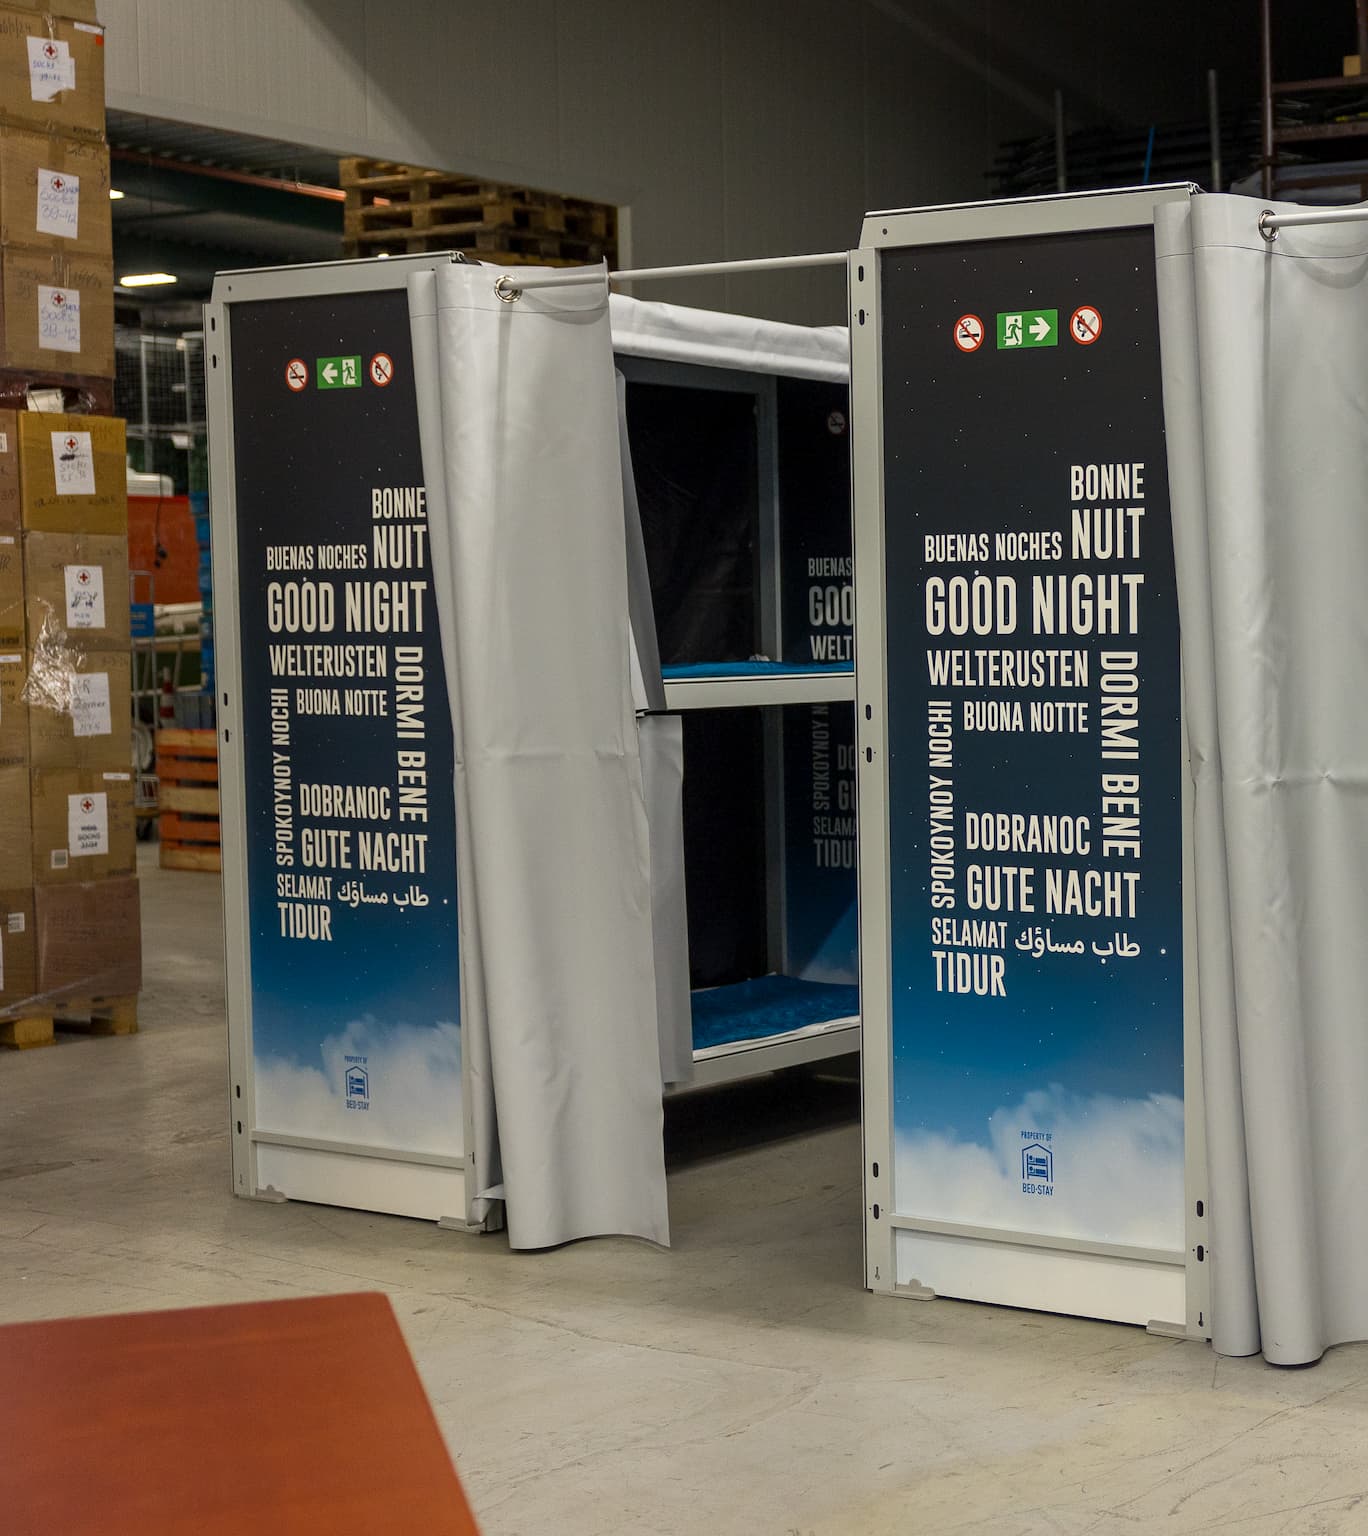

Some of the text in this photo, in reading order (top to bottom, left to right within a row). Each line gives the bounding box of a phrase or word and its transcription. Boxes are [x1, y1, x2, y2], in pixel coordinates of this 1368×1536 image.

[1070, 463, 1145, 500] BONNE
[372, 487, 426, 518] BONNE
[373, 524, 427, 569] NUIT
[924, 531, 1062, 562] BUENAS NOCHES
[1071, 507, 1145, 559] NUIT
[266, 544, 367, 570] BUENAS NOCHES
[808, 557, 852, 576] BUENAS
[267, 581, 427, 633] GOOD NIGHT
[809, 585, 853, 626] GOO
[925, 573, 1145, 635] GOOD NIGHT
[269, 644, 387, 678] WELTERUSTEN
[926, 650, 1089, 687] WELTERUSTEN
[296, 688, 388, 716] BUONA NOTTE
[963, 701, 1089, 733] BUONA NOTTE
[395, 646, 428, 823] DORMI BENE
[1100, 651, 1141, 858] DORMI BENE
[271, 688, 294, 867] SPOKOYNOY NOCHI
[812, 719, 830, 811] SPOKOYNOY
[300, 783, 391, 820] DOBRANOC
[928, 700, 955, 909] SPOKOYNOY NOCHI
[301, 828, 428, 874] GUTE NACHT
[965, 812, 1090, 855] DOBRANOC
[277, 873, 332, 900] SELAMAT
[966, 864, 1141, 918] GUTE NACHT
[277, 902, 333, 942] TIDUR
[931, 917, 1007, 949] SELAMAT
[931, 951, 1007, 997] TIDUR
[1022, 1183, 1053, 1196] BED-STAY
